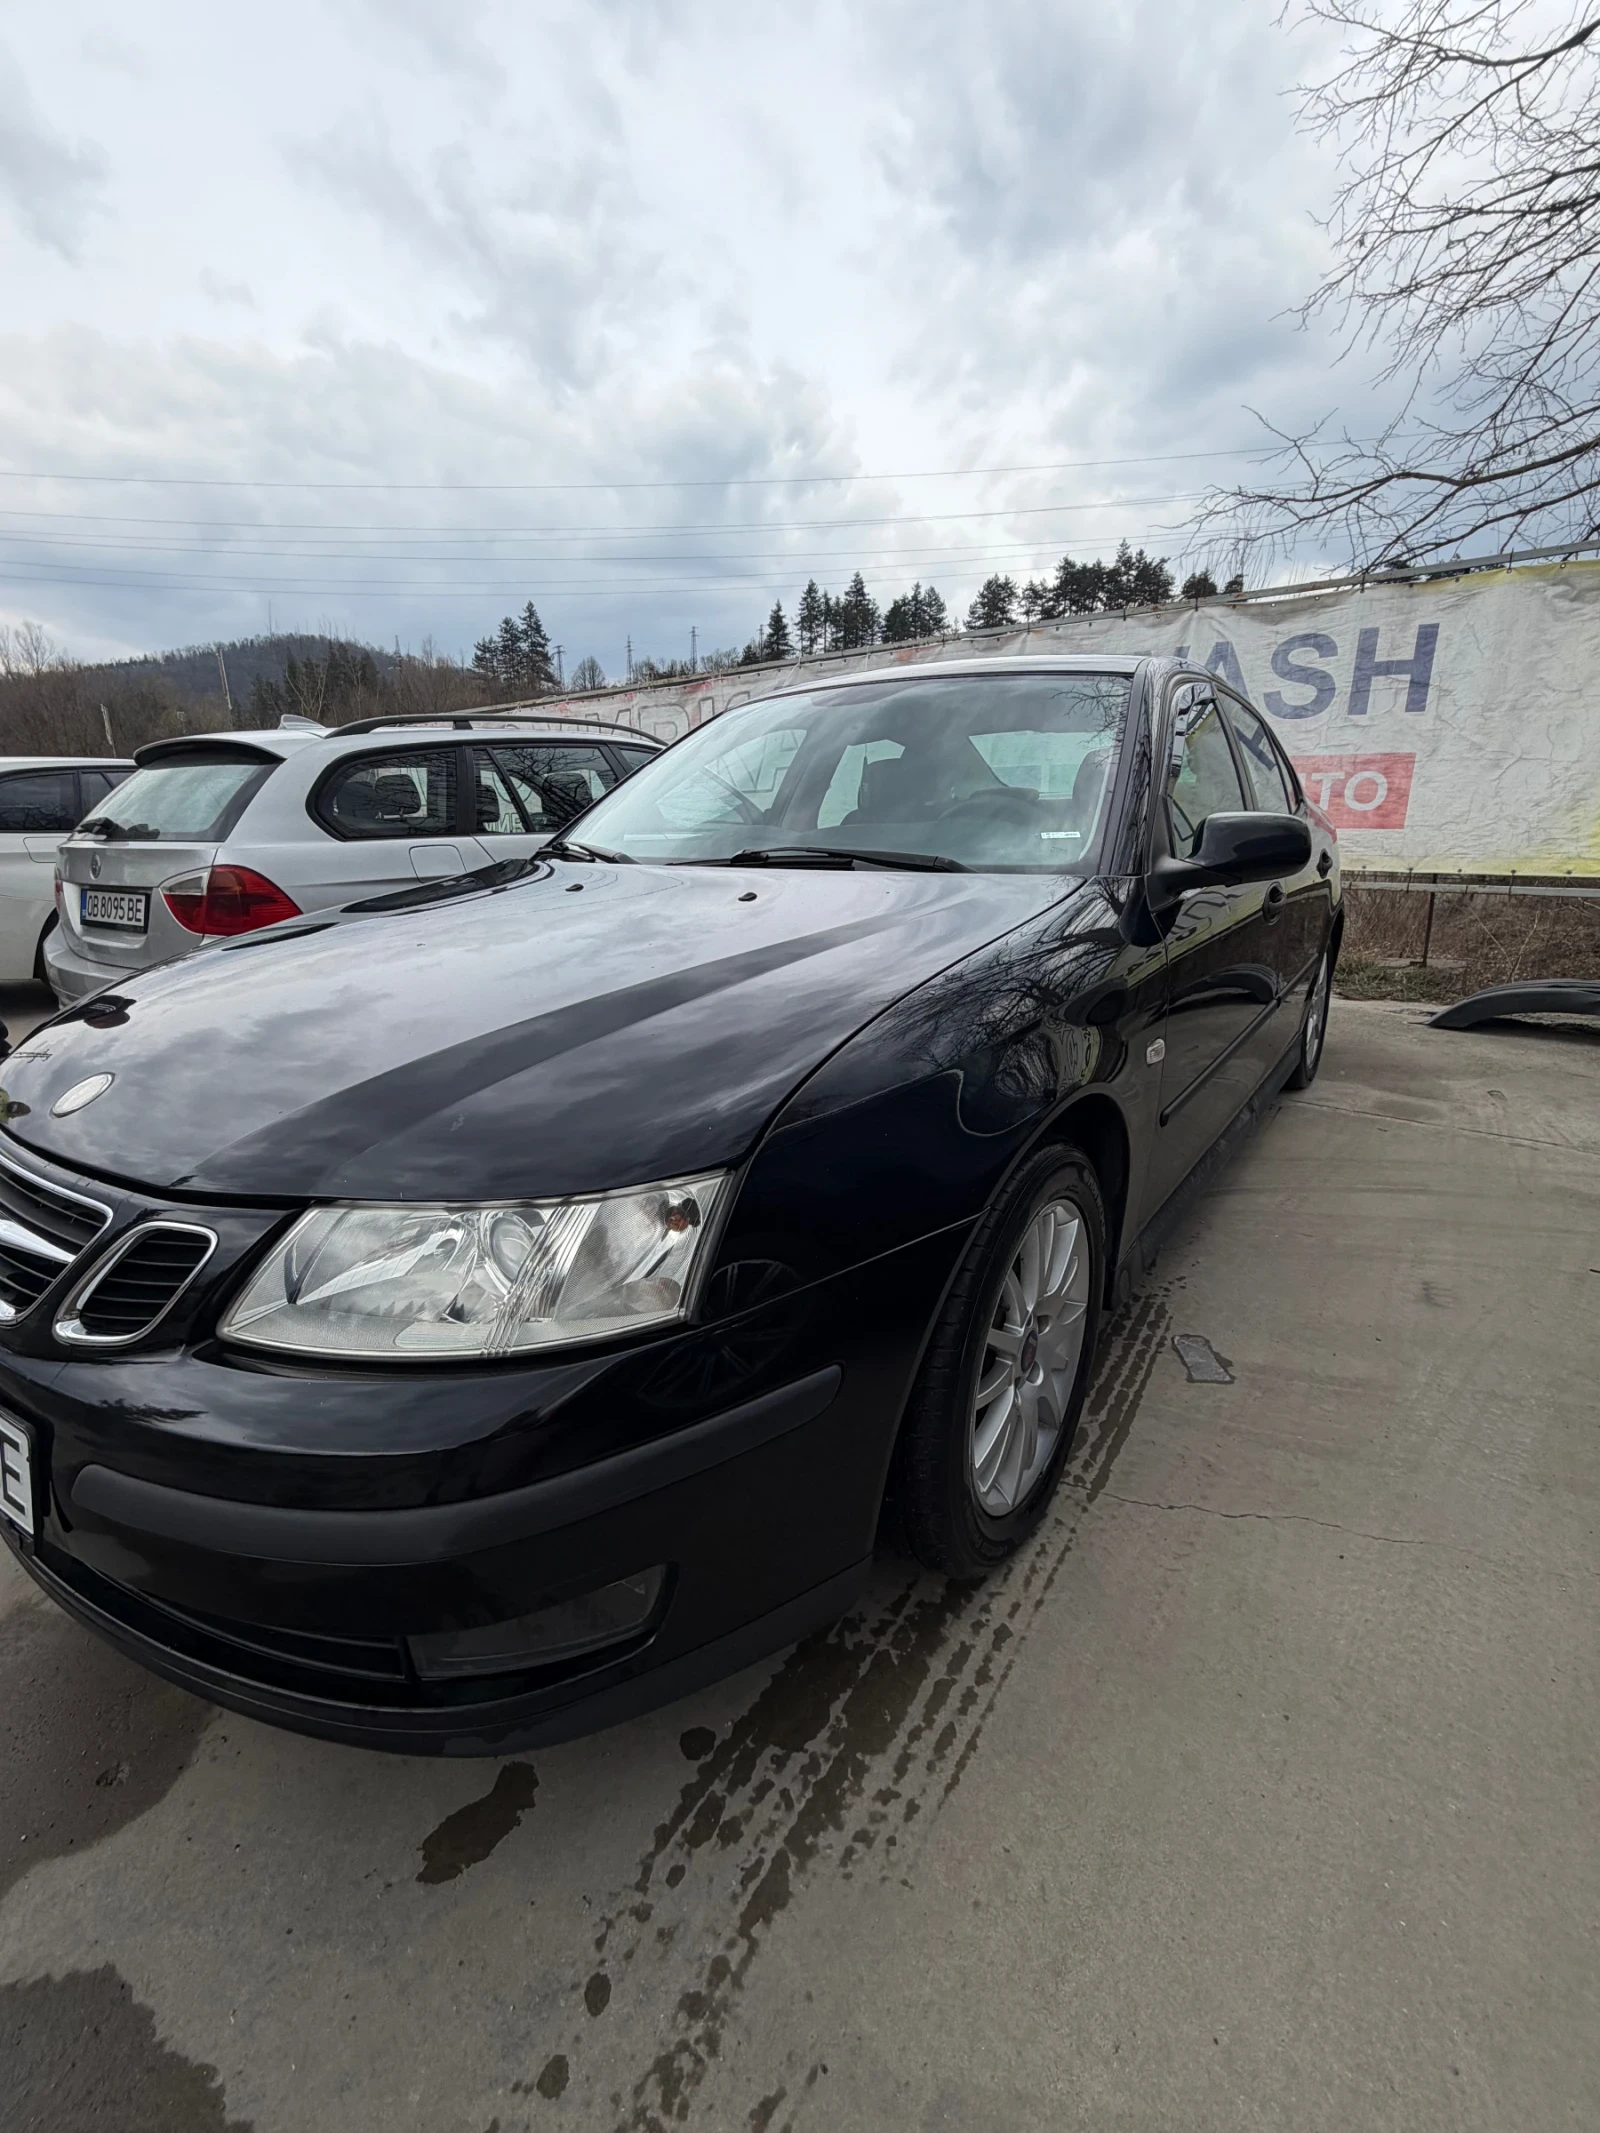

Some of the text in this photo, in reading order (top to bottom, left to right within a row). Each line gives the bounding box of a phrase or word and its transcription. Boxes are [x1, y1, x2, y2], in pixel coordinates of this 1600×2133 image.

[1133, 622, 1440, 720] ASH
[1298, 770, 1388, 811] TO
[100, 896, 126, 920] 8095
[127, 898, 143, 922] BE
